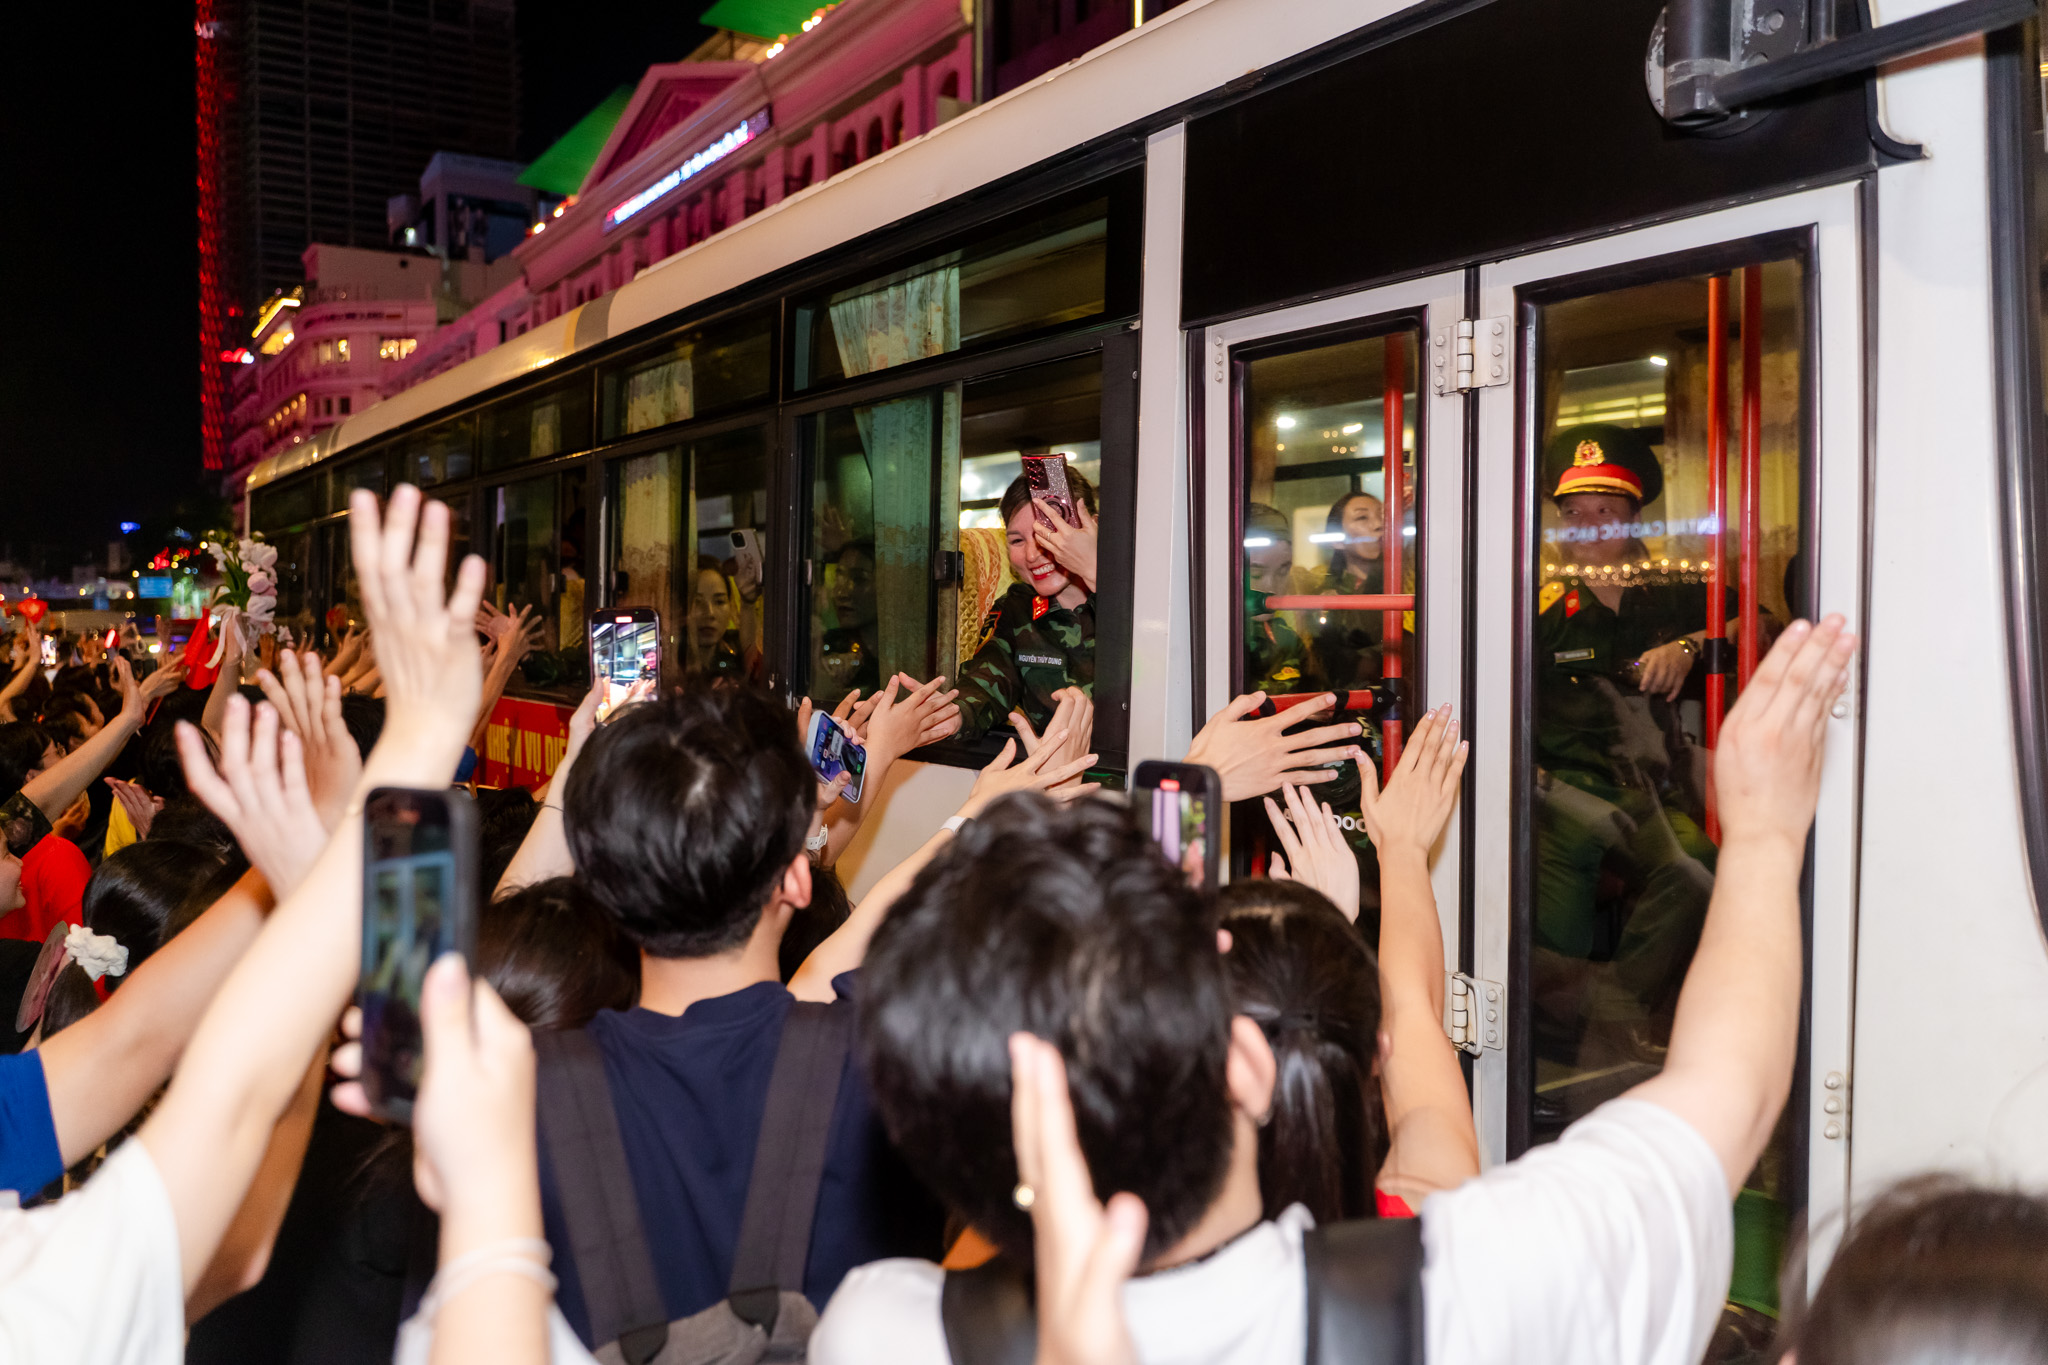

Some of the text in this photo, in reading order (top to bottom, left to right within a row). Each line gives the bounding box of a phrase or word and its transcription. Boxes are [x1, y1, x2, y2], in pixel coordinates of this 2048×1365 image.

[1018, 653, 1037, 664] NGUYỄN
[486, 717, 568, 783] NHIỆM VỤ DIỄ
